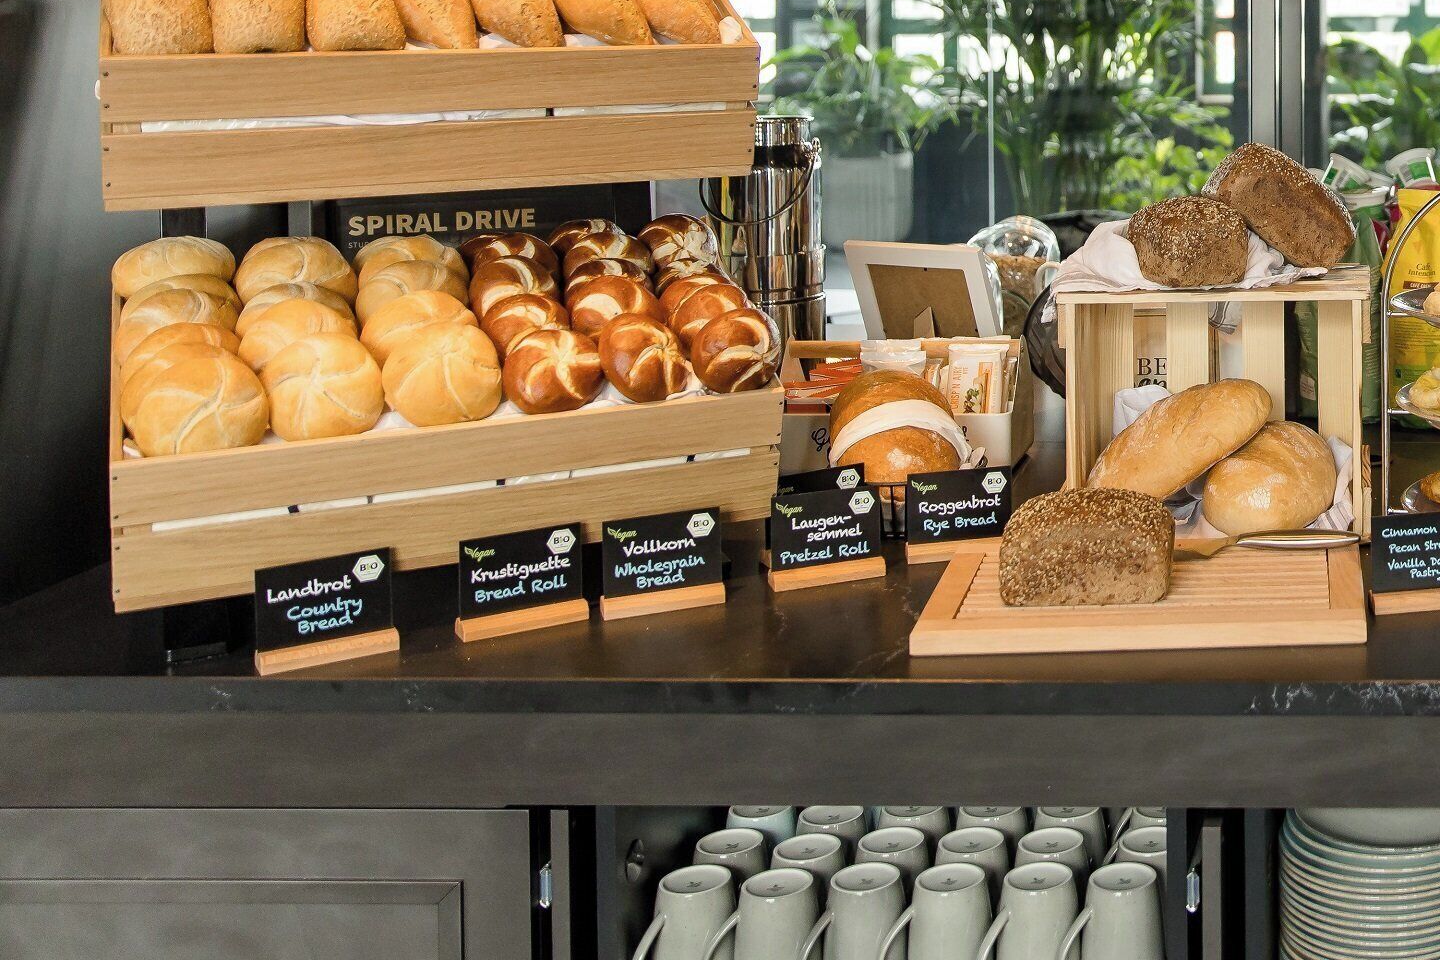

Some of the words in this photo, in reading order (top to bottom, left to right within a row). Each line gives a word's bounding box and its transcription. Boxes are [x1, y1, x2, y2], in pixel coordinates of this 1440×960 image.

[348, 212, 448, 237] SPIRAL
[455, 208, 536, 231] DRIVE
[918, 493, 1002, 515] Roggenbrot
[791, 515, 852, 531] Laugen-
[806, 523, 864, 542] semmel
[923, 519, 950, 537] Rye
[954, 511, 998, 528] Bread
[1381, 525, 1437, 538] Cinnamon
[622, 536, 697, 558] Vollkorn
[780, 546, 834, 565] Pretzel
[838, 540, 871, 557] Roll
[1388, 542, 1421, 554] Pecan
[470, 555, 572, 584] Krustiguette
[614, 554, 706, 578] Wholegrain
[1387, 558, 1426, 570] Vanilla
[266, 575, 352, 604] Landbrot
[474, 580, 526, 604] Bread
[530, 574, 568, 593] Roll
[635, 569, 686, 589] Bread
[286, 596, 364, 621] Country
[297, 611, 354, 635] Bread
